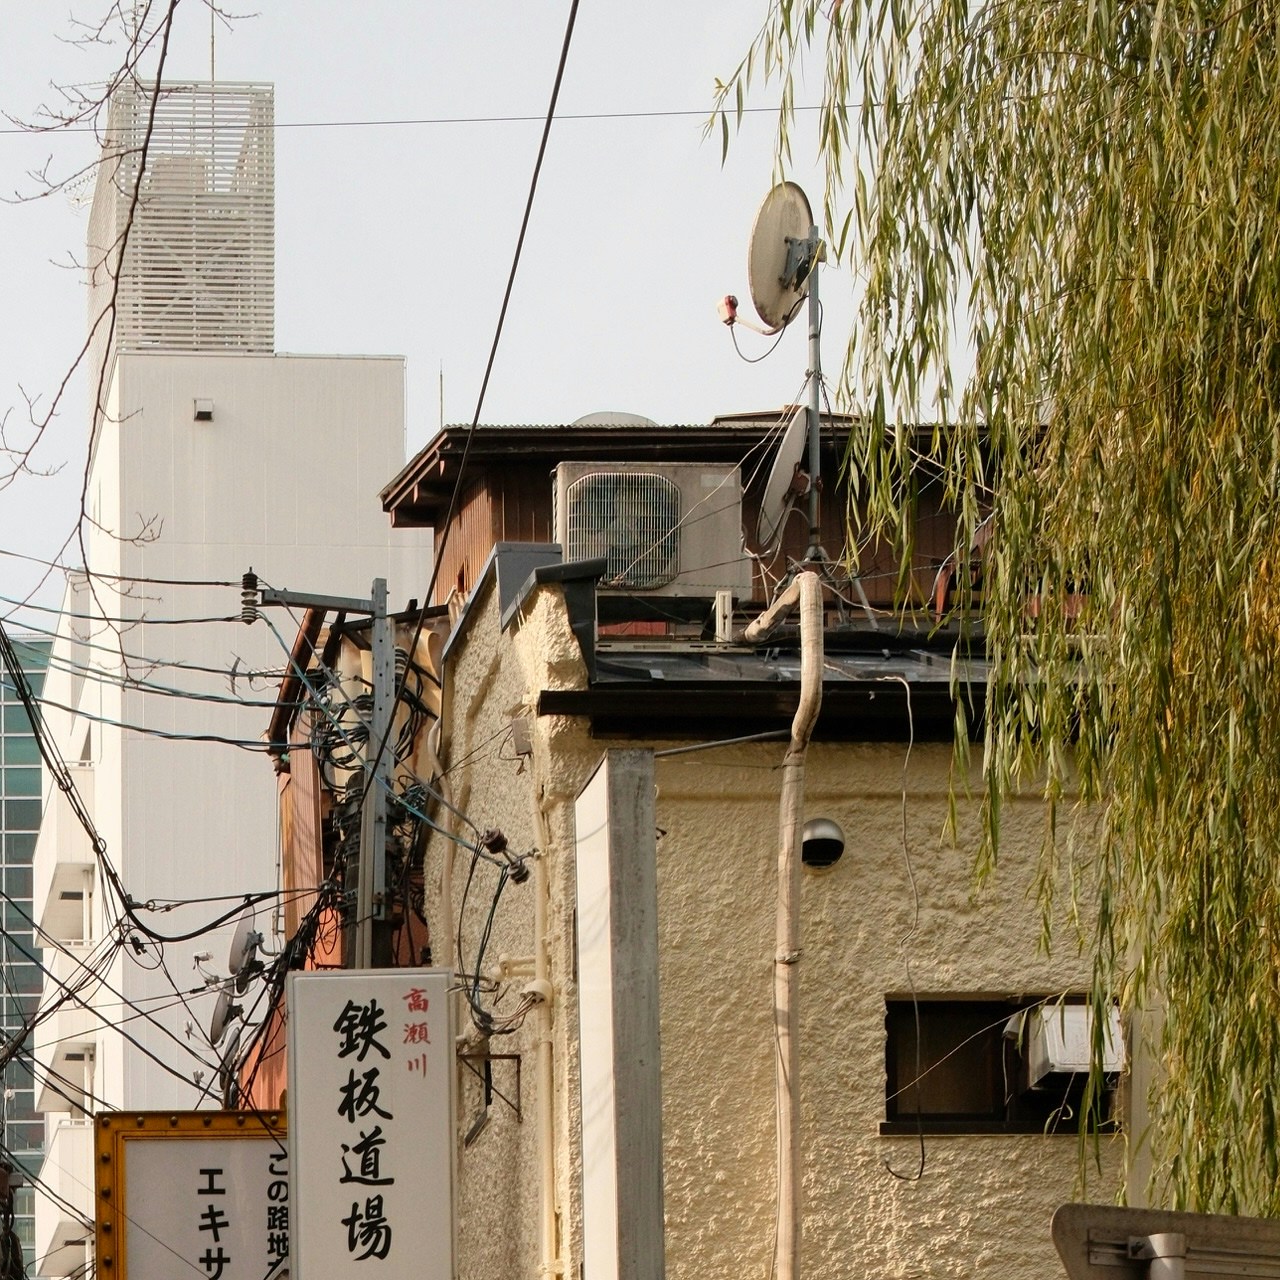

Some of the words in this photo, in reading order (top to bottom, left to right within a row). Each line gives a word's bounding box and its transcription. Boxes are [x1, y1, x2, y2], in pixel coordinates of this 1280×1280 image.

[402, 988, 432, 1079] 高瀬川
[333, 998, 395, 1261] 鉄板道場
[267, 1152, 290, 1268] この路地
